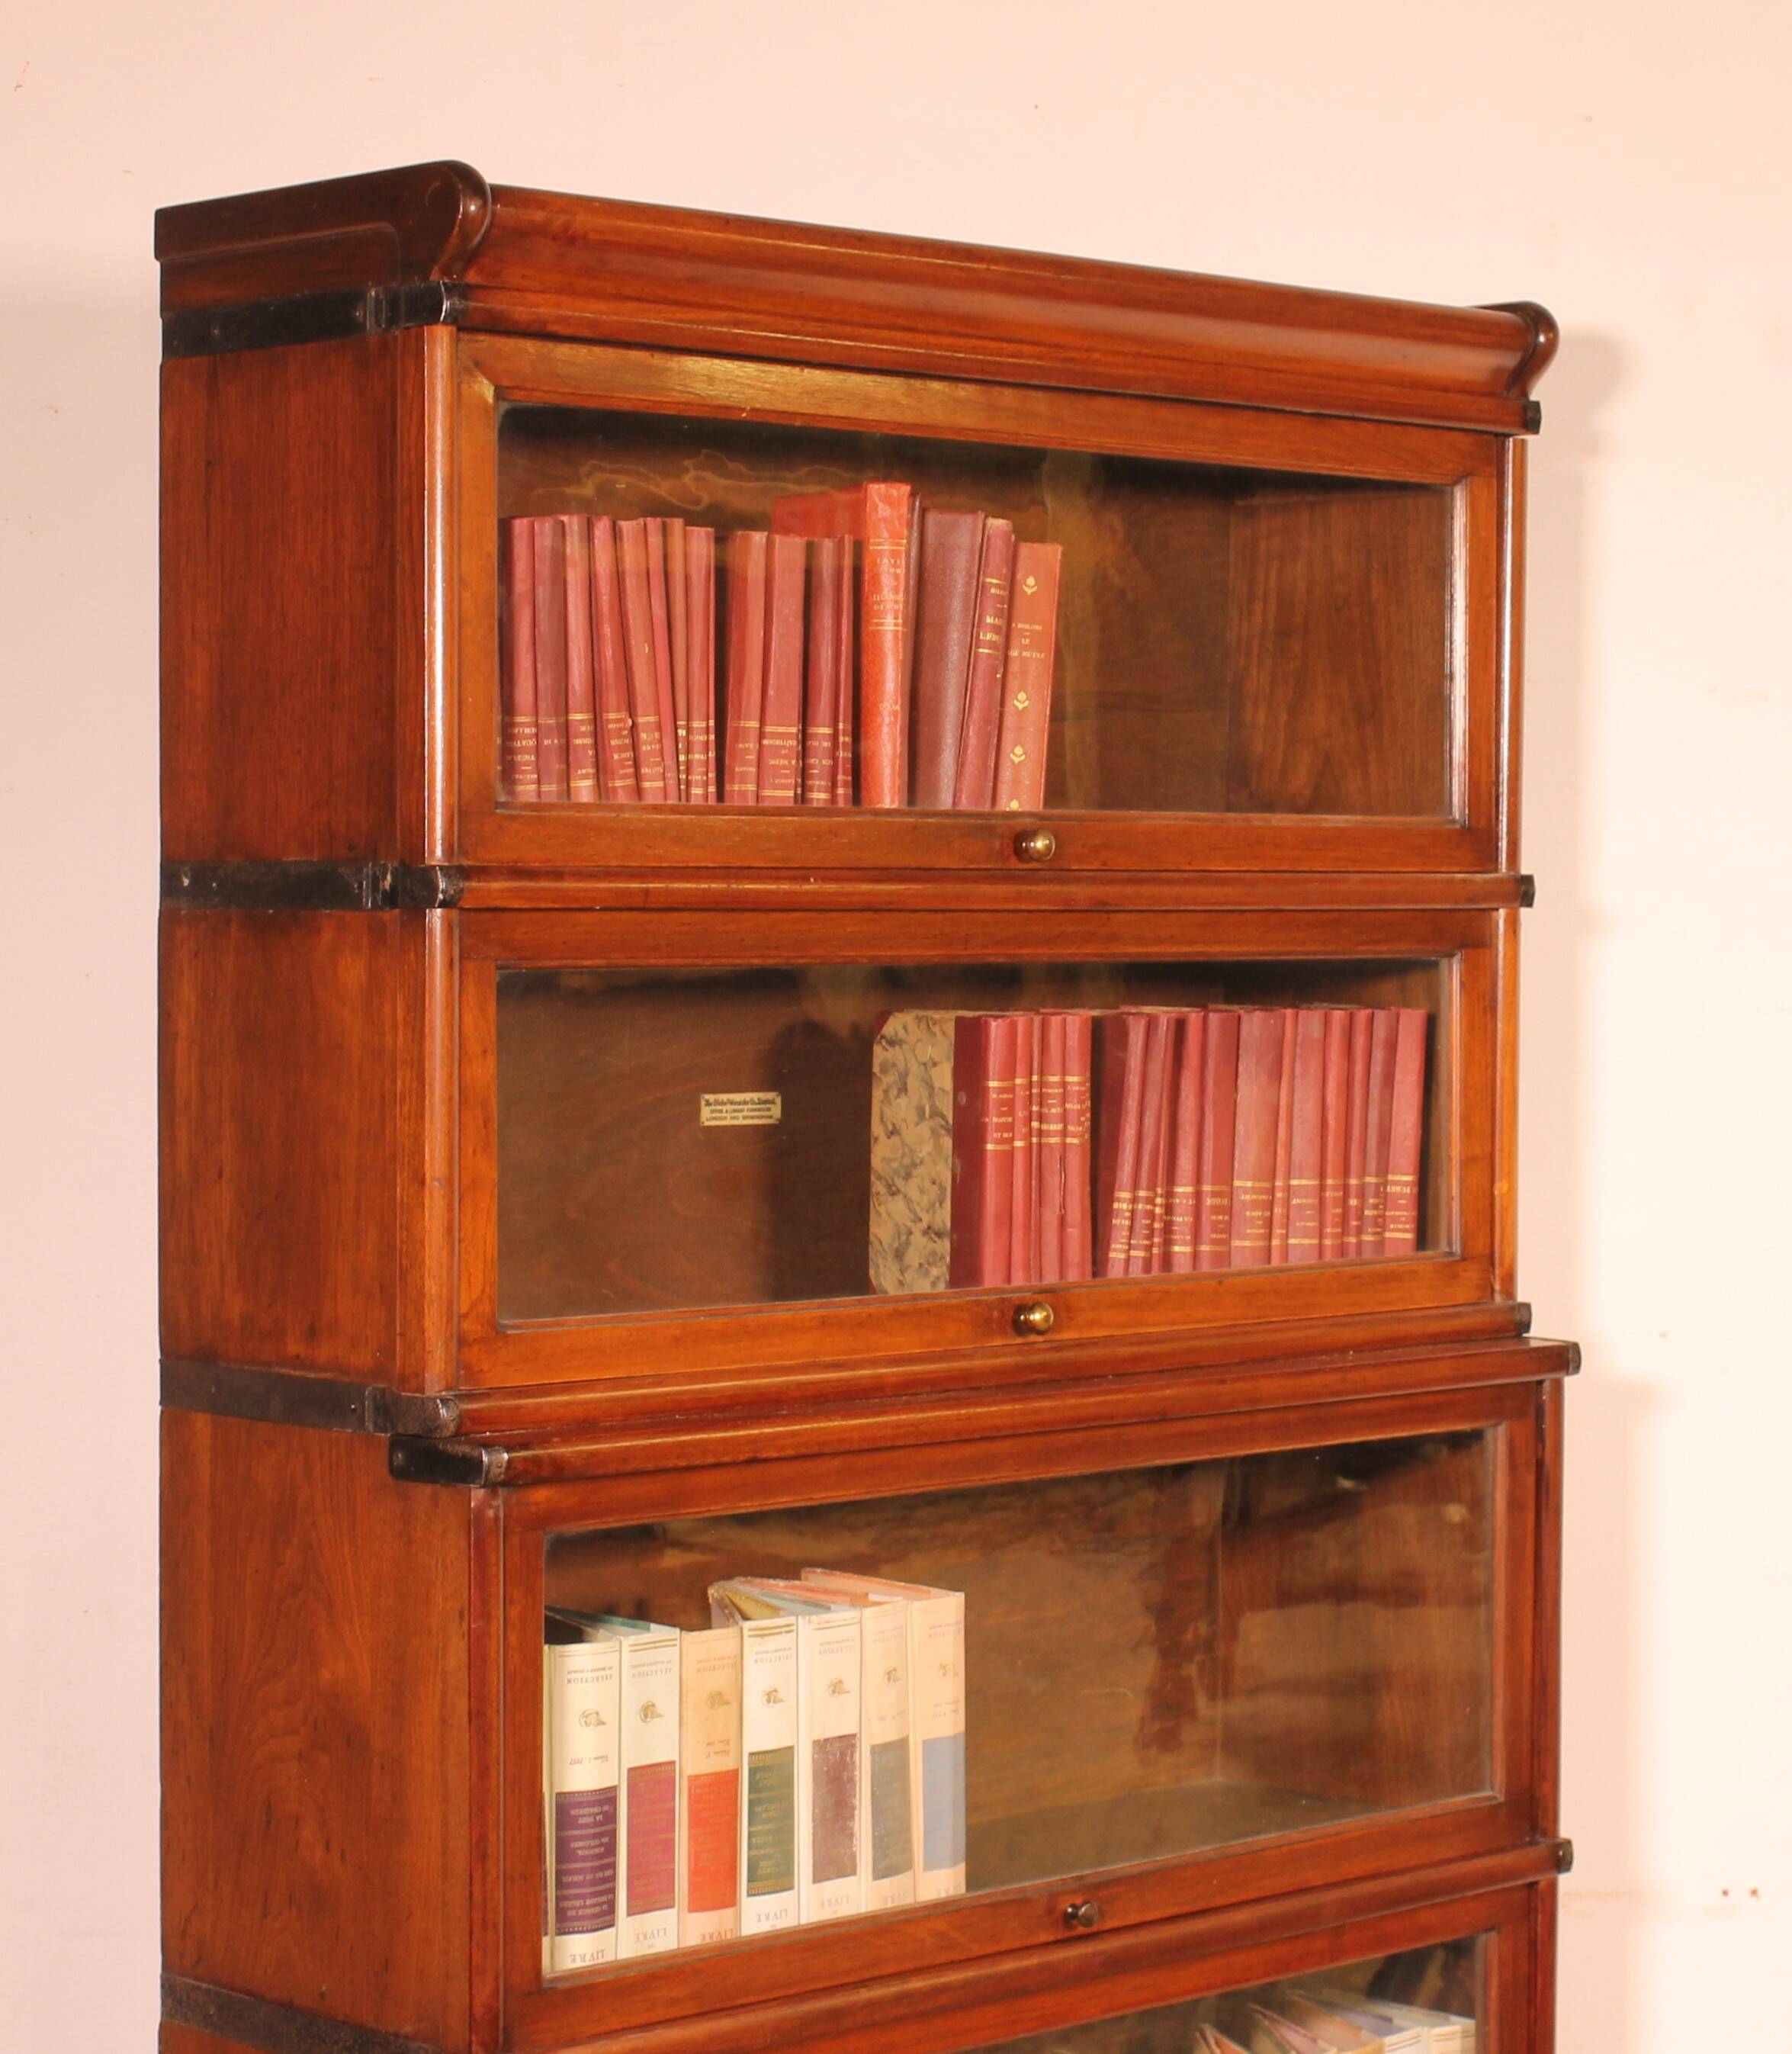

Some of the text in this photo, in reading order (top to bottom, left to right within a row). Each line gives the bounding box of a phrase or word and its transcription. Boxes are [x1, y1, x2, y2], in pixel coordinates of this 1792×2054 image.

[755, 1908, 788, 1923] LIVRE
[633, 1927, 667, 1945] LIVRE
[700, 1927, 734, 1943] LIVRE
[570, 1949, 605, 1965] LIVRE
